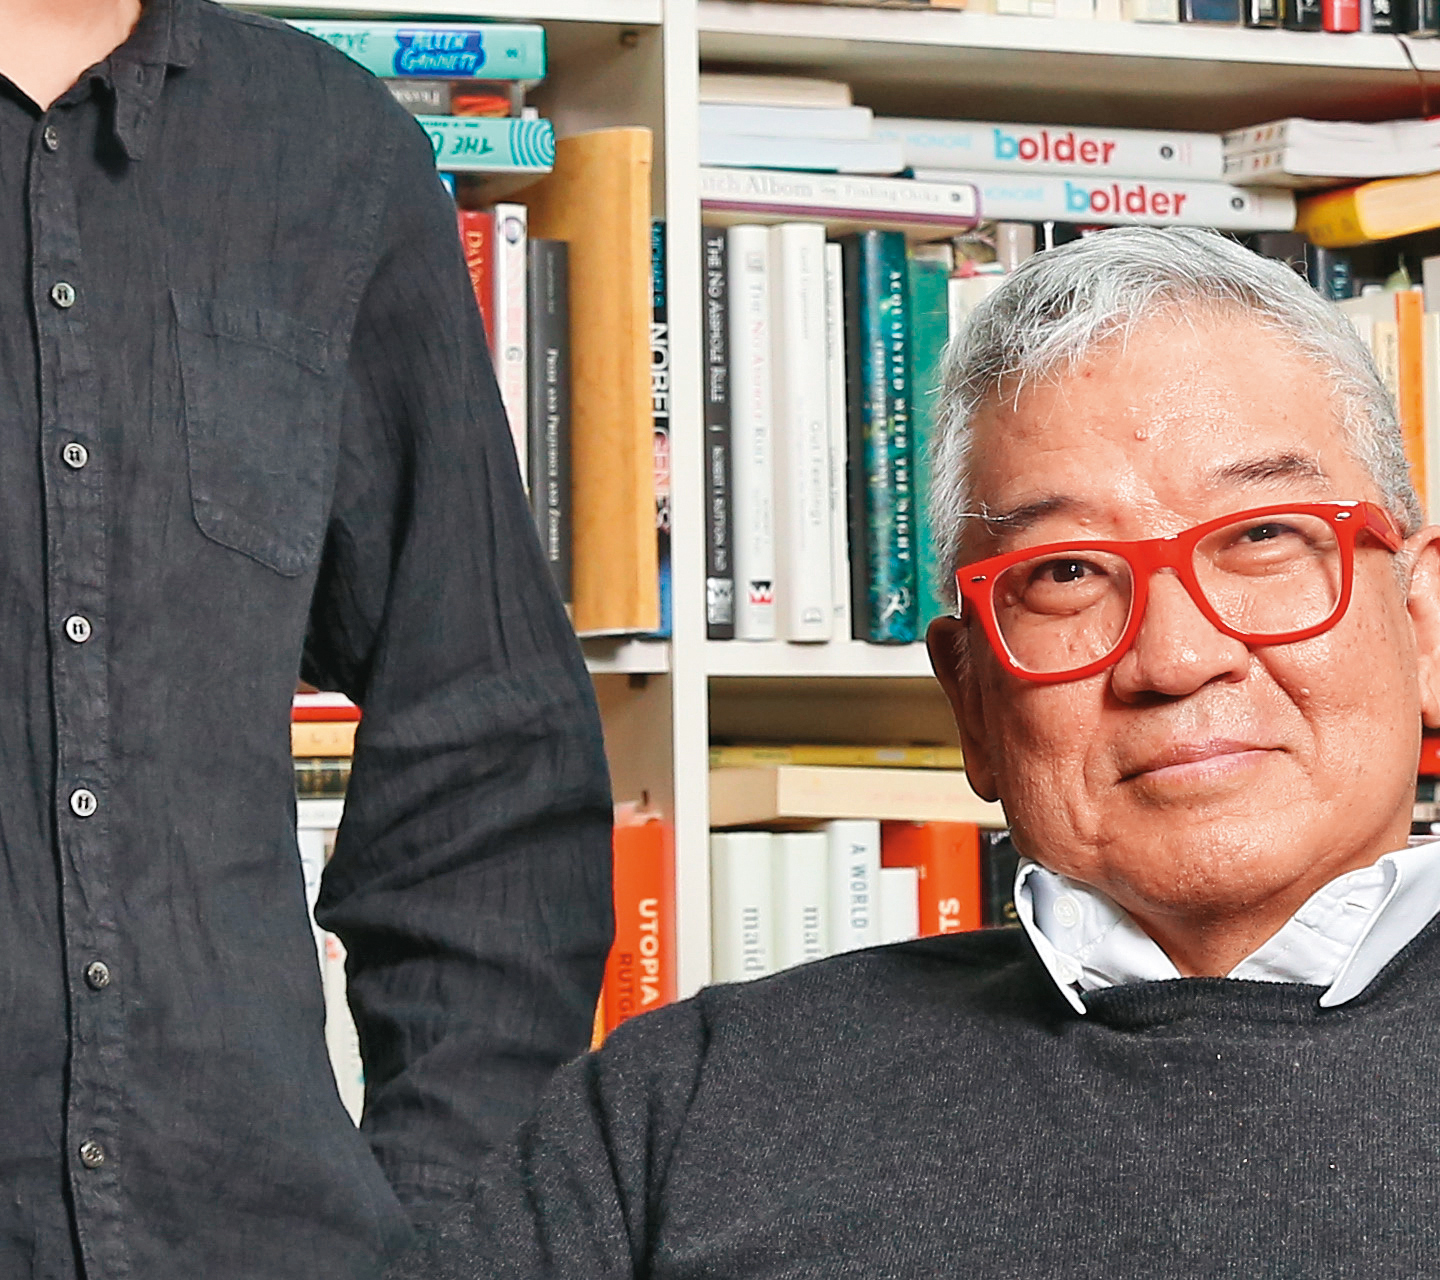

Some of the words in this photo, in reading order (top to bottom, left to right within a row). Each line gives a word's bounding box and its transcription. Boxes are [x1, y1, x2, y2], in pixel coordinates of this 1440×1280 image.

[451, 135, 495, 156] THE
[993, 128, 1115, 164] bolder
[1064, 180, 1186, 215] bolder
[707, 236, 724, 269] THE
[708, 270, 725, 298] NO
[709, 300, 726, 363] ASSHOLE
[710, 366, 727, 403] RULE
[639, 897, 659, 1006] UTOPIA
